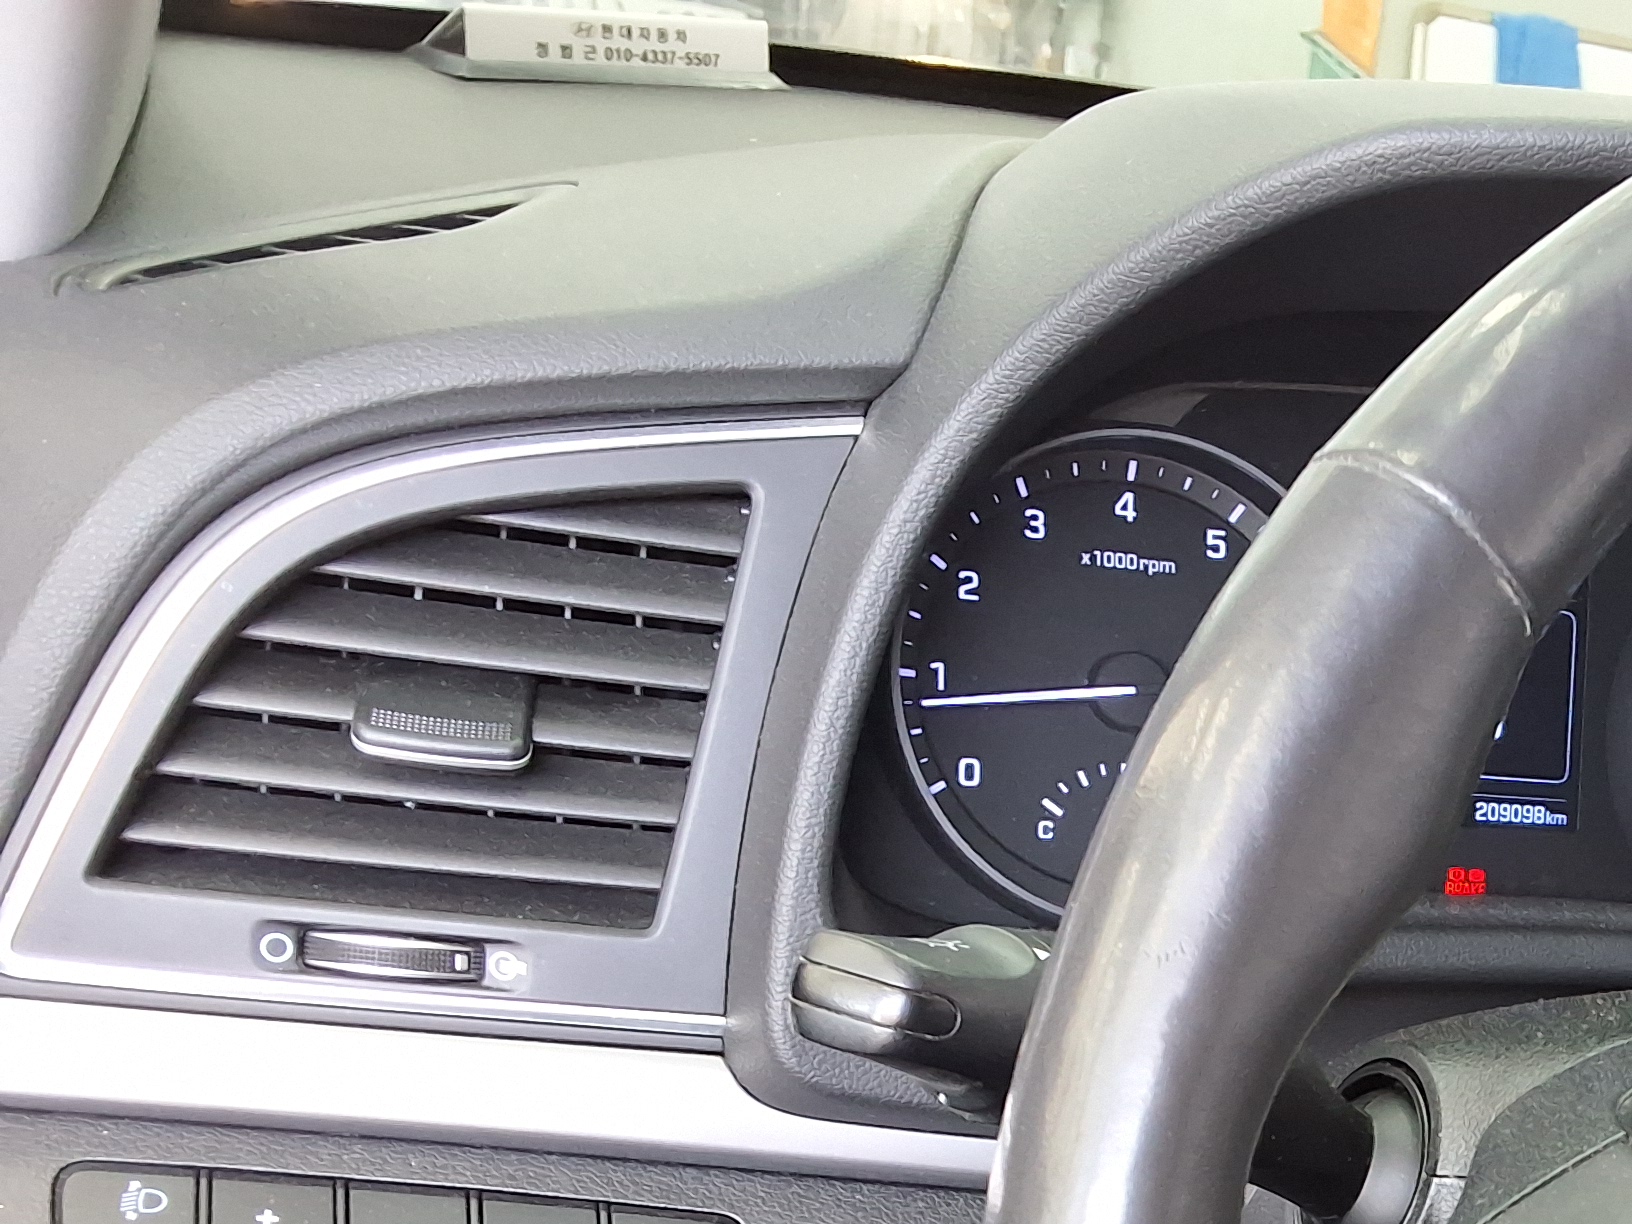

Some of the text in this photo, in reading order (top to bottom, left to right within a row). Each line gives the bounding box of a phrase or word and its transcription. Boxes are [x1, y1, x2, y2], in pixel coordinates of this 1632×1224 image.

[1113, 491, 1137, 522] 4
[1023, 508, 1047, 540] 3
[1205, 528, 1228, 560] 5
[957, 570, 980, 601] 2
[929, 661, 946, 692] 1
[957, 757, 982, 788] 0
[1037, 820, 1055, 841] C
